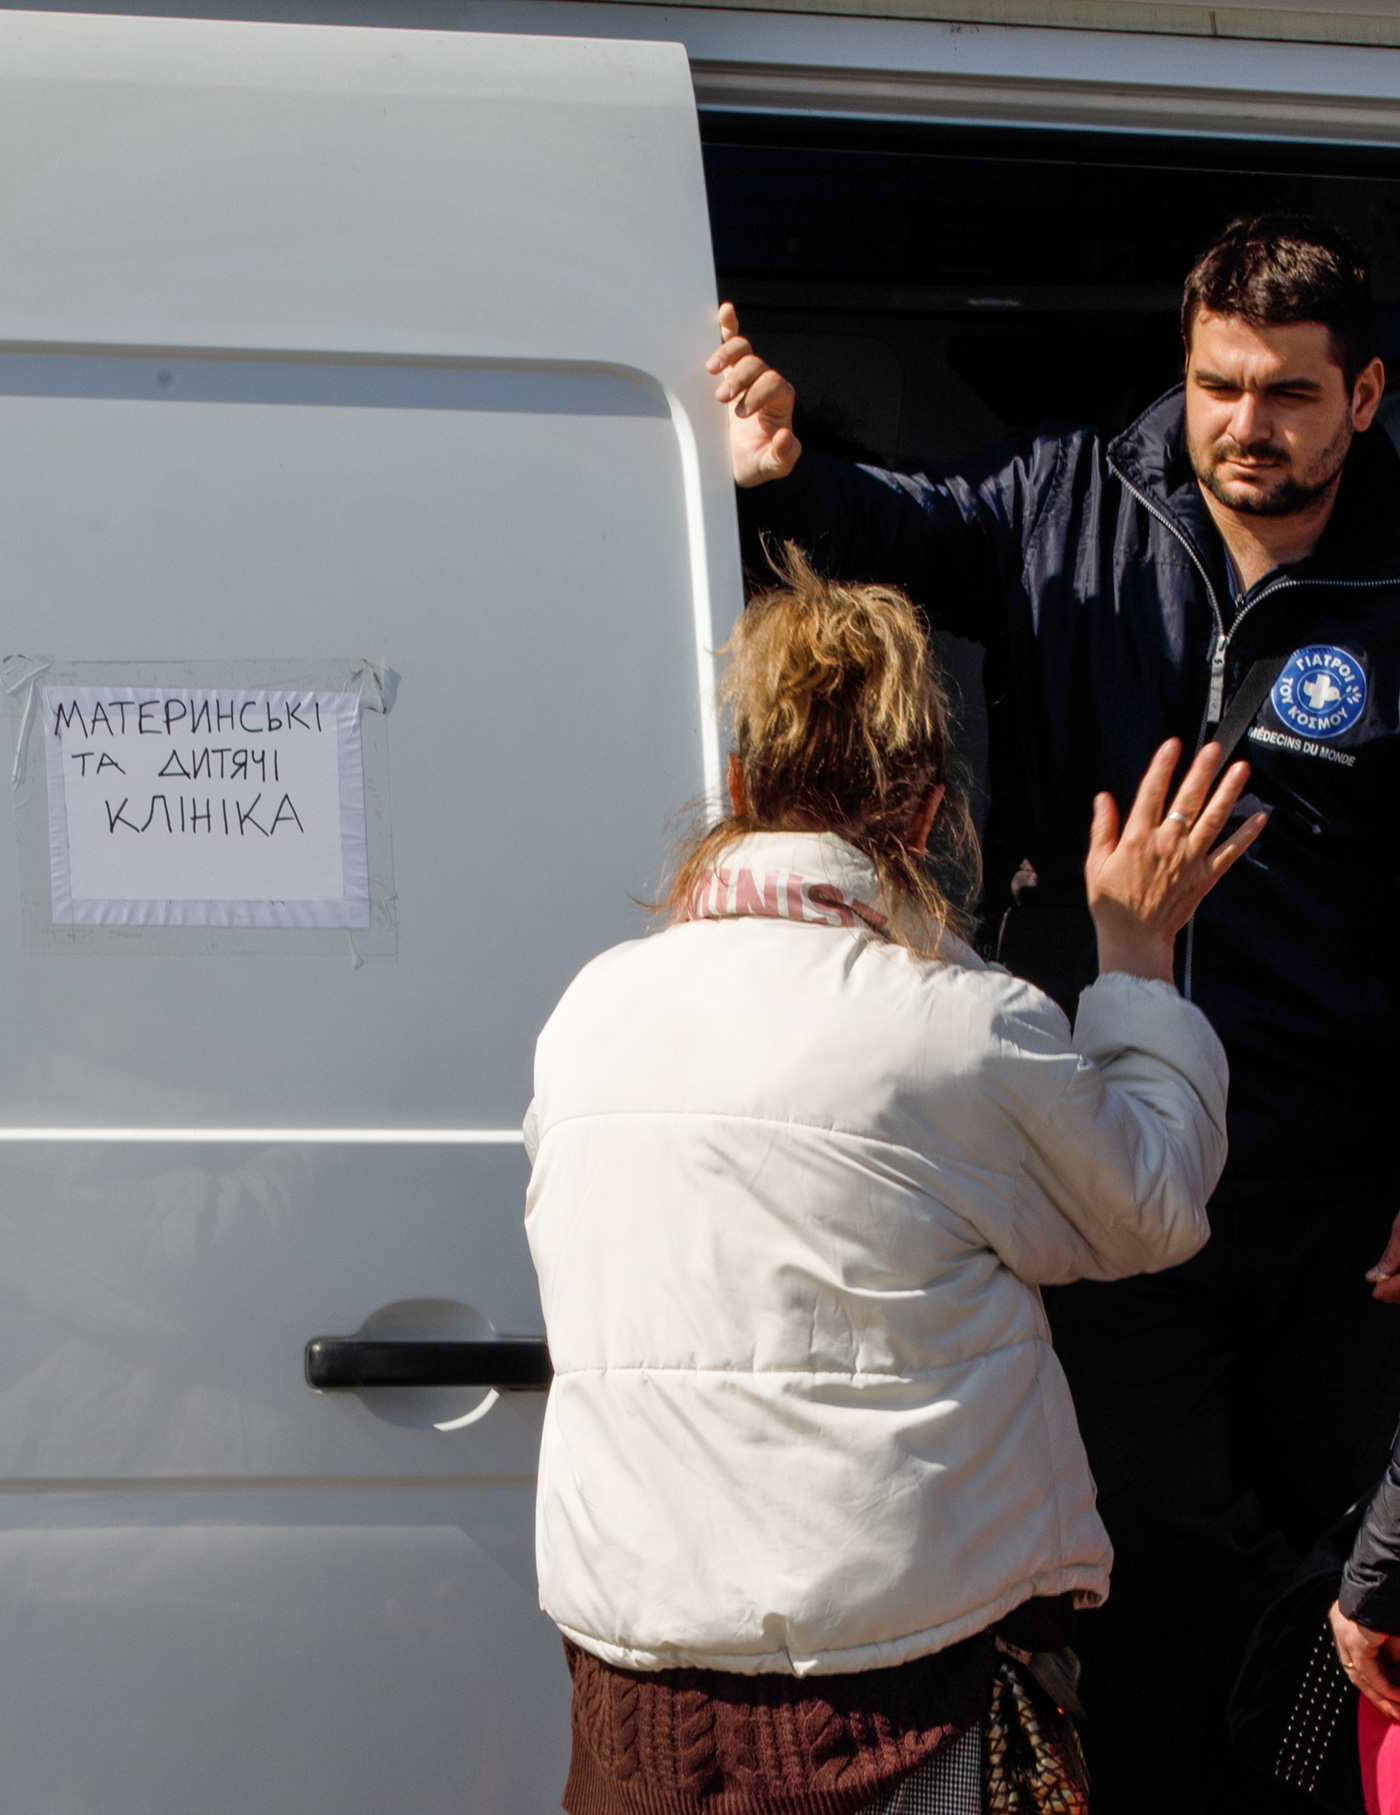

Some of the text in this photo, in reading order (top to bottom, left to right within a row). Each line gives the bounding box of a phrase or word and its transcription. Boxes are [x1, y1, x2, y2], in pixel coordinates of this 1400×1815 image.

[1296, 654, 1355, 683] ΓΙΑΤΡΟΙ
[54, 699, 322, 739] МАТЕРИНСЬКІ
[1280, 677, 1348, 730] ΤΟΥ ΚΟΣΜΟΥ
[71, 748, 280, 782] ТА ДИТЯЧІ
[1248, 726, 1356, 767] MÉDECINS DU MONDE
[105, 793, 304, 837] КЛІНІКА
